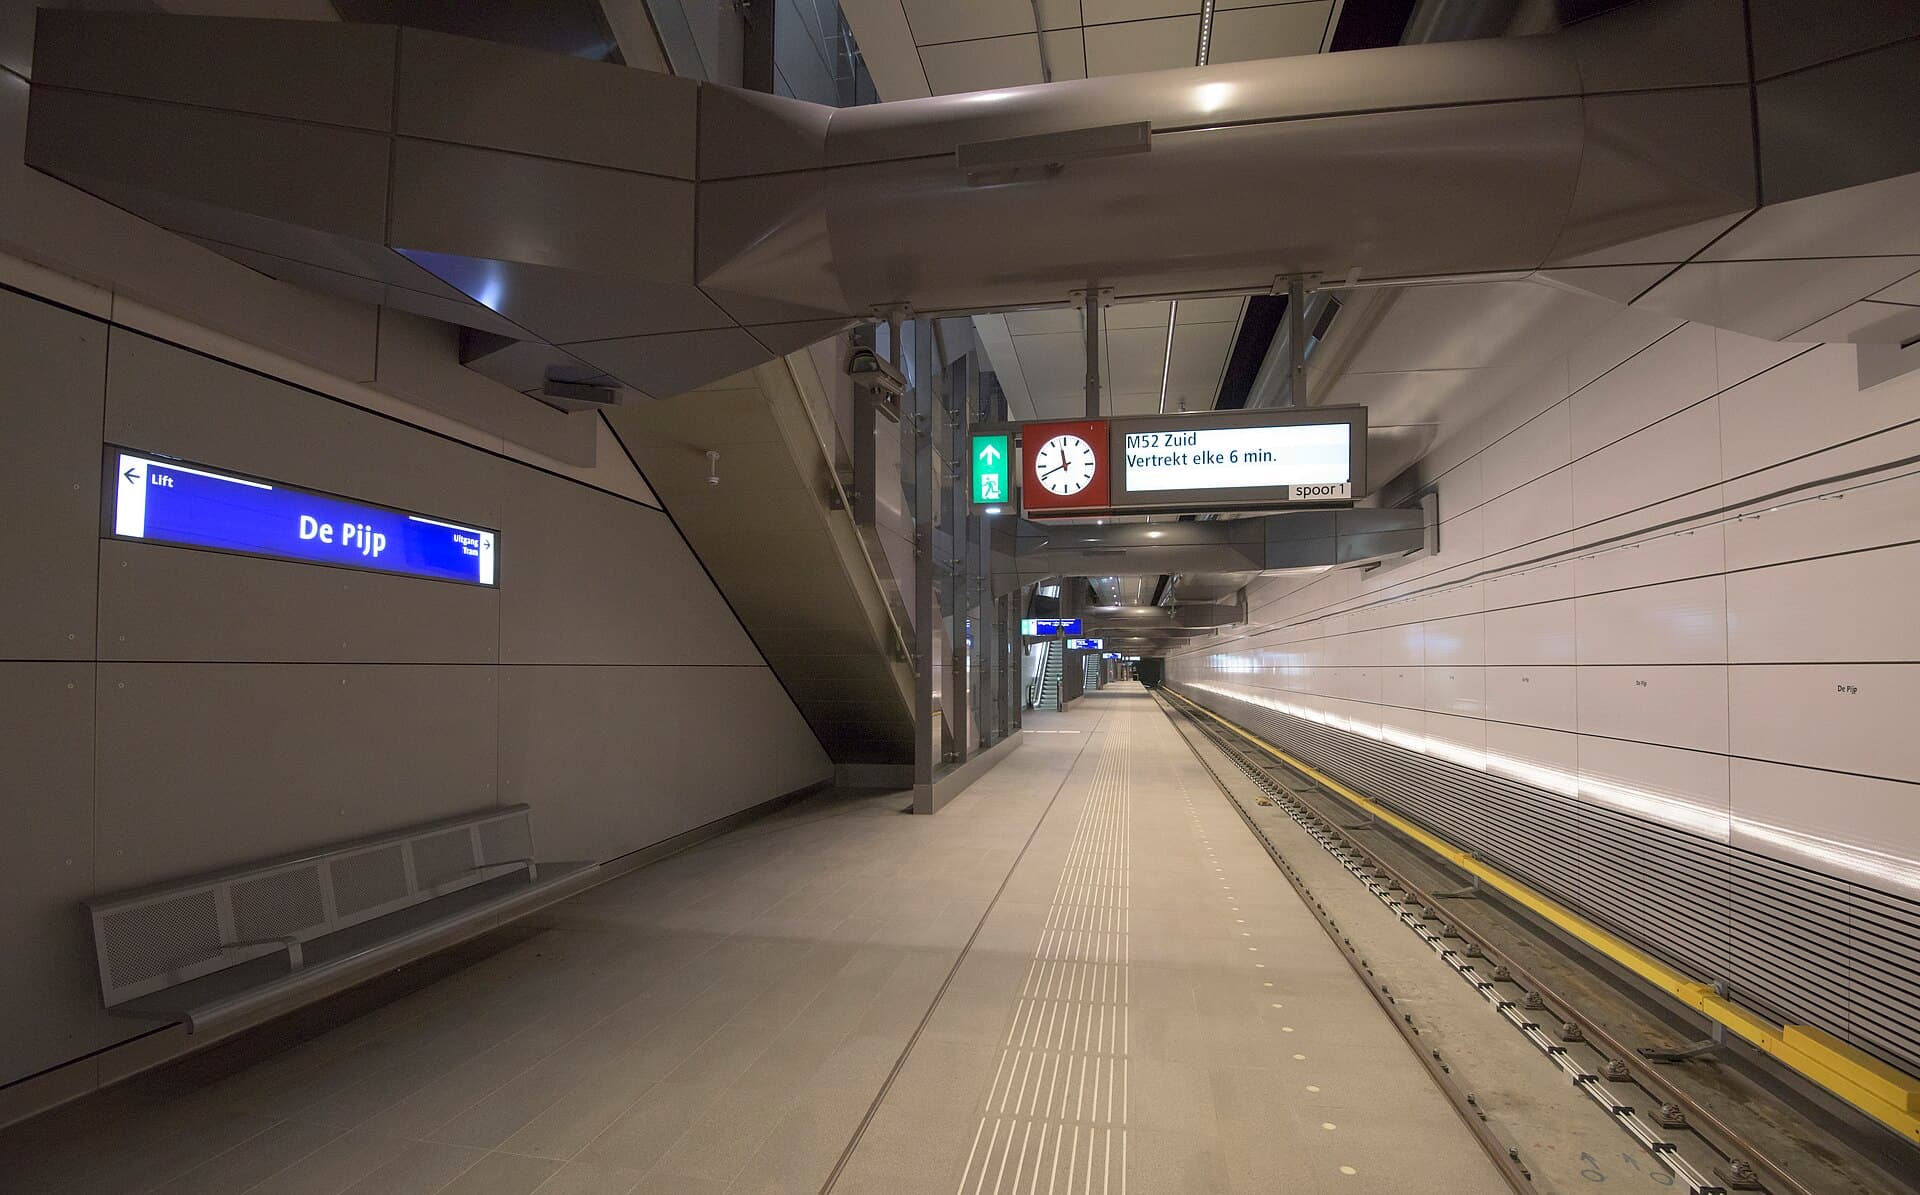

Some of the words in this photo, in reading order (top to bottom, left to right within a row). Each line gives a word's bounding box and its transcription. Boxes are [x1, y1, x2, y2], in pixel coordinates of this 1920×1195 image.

[1127, 435, 1159, 448] M52
[1165, 432, 1197, 447] Zuid
[1127, 453, 1188, 467] Vertrekt
[1193, 450, 1224, 465] elke
[1230, 450, 1239, 463] 6
[1244, 449, 1277, 463] min.
[151, 474, 174, 488] Lift
[1296, 484, 1335, 498] spoor
[1339, 484, 1345, 494] 1
[300, 515, 333, 543] De
[342, 522, 386, 557] Pijp
[453, 534, 479, 547] Uitgang
[463, 547, 479, 556] Tram
